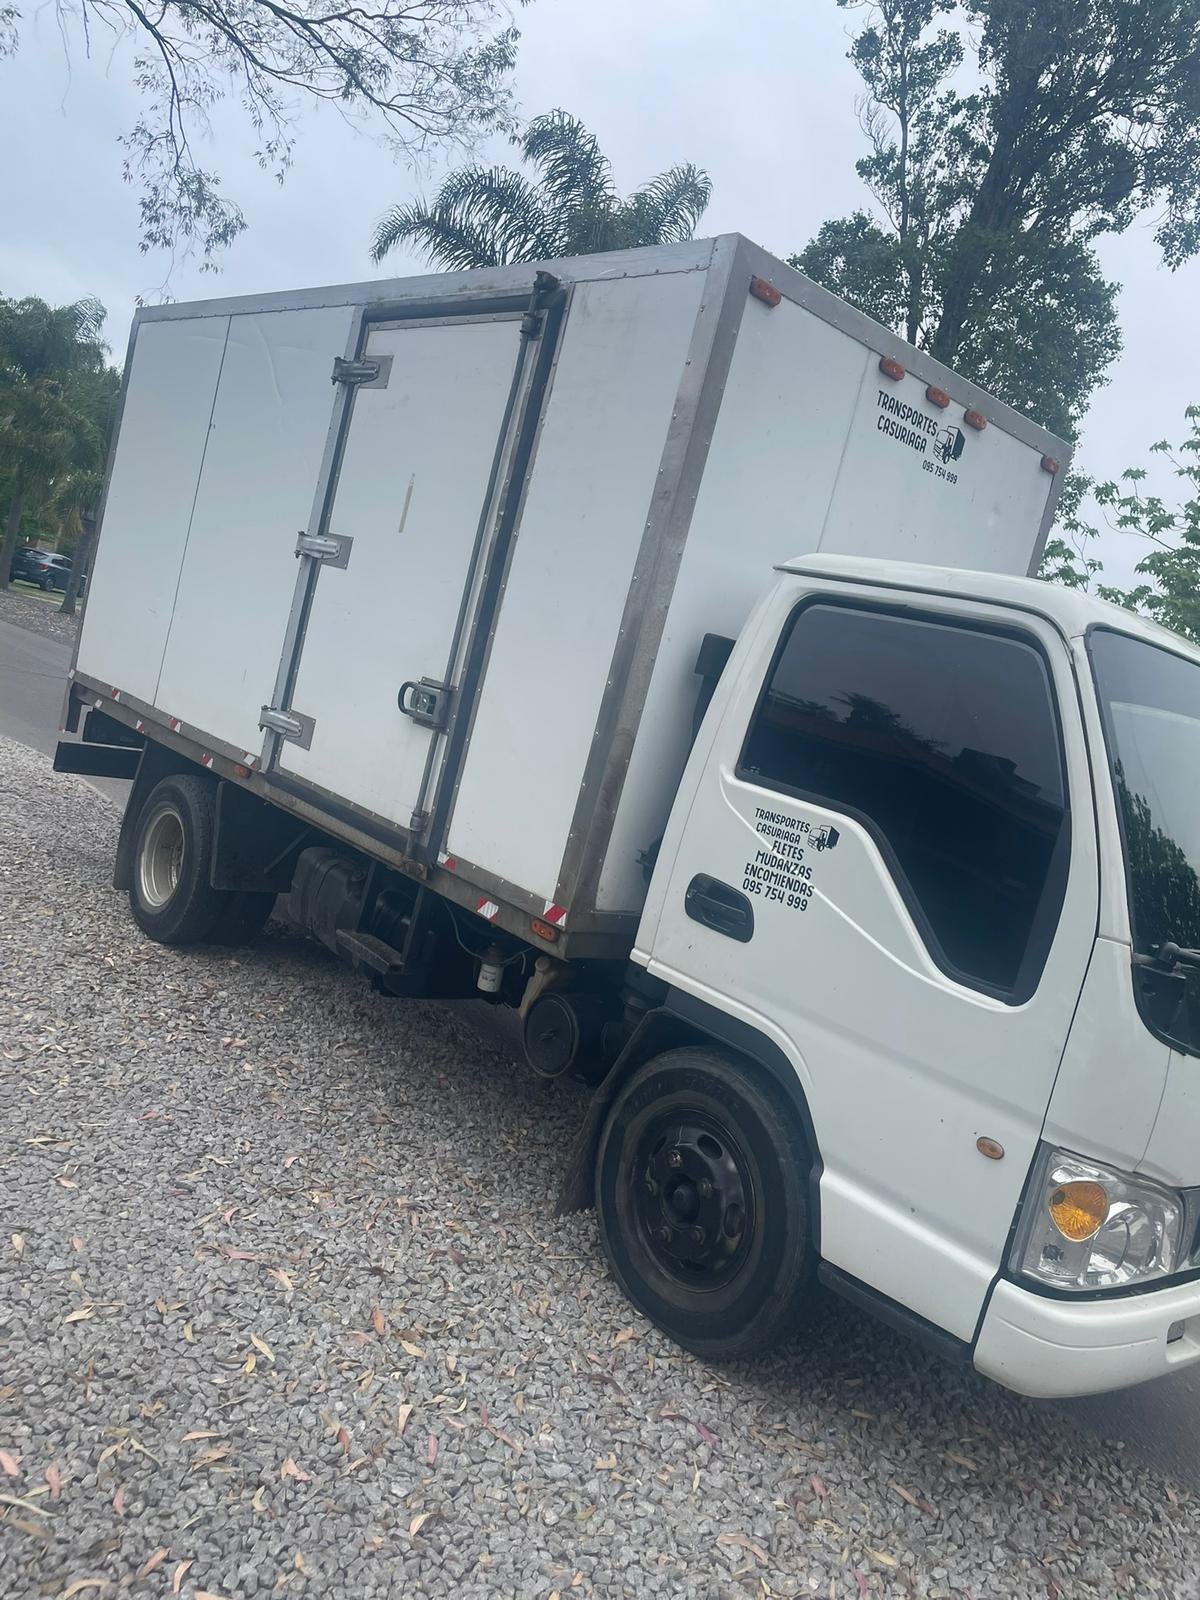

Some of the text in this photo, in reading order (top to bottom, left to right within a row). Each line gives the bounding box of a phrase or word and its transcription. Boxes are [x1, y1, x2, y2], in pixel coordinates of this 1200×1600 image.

[877, 390, 938, 436] TRANSPORTES
[877, 415, 927, 453] CASURIAGA
[922, 460, 958, 485] 095 754 999
[755, 808, 811, 833] TRANSPORTES
[756, 822, 801, 845] CASURIAGA
[755, 850, 813, 880] MUDANZAS
[771, 840, 805, 861] FLETES
[742, 878, 808, 912] 095 754 999
[744, 863, 815, 898] ENCOMIENDAS
